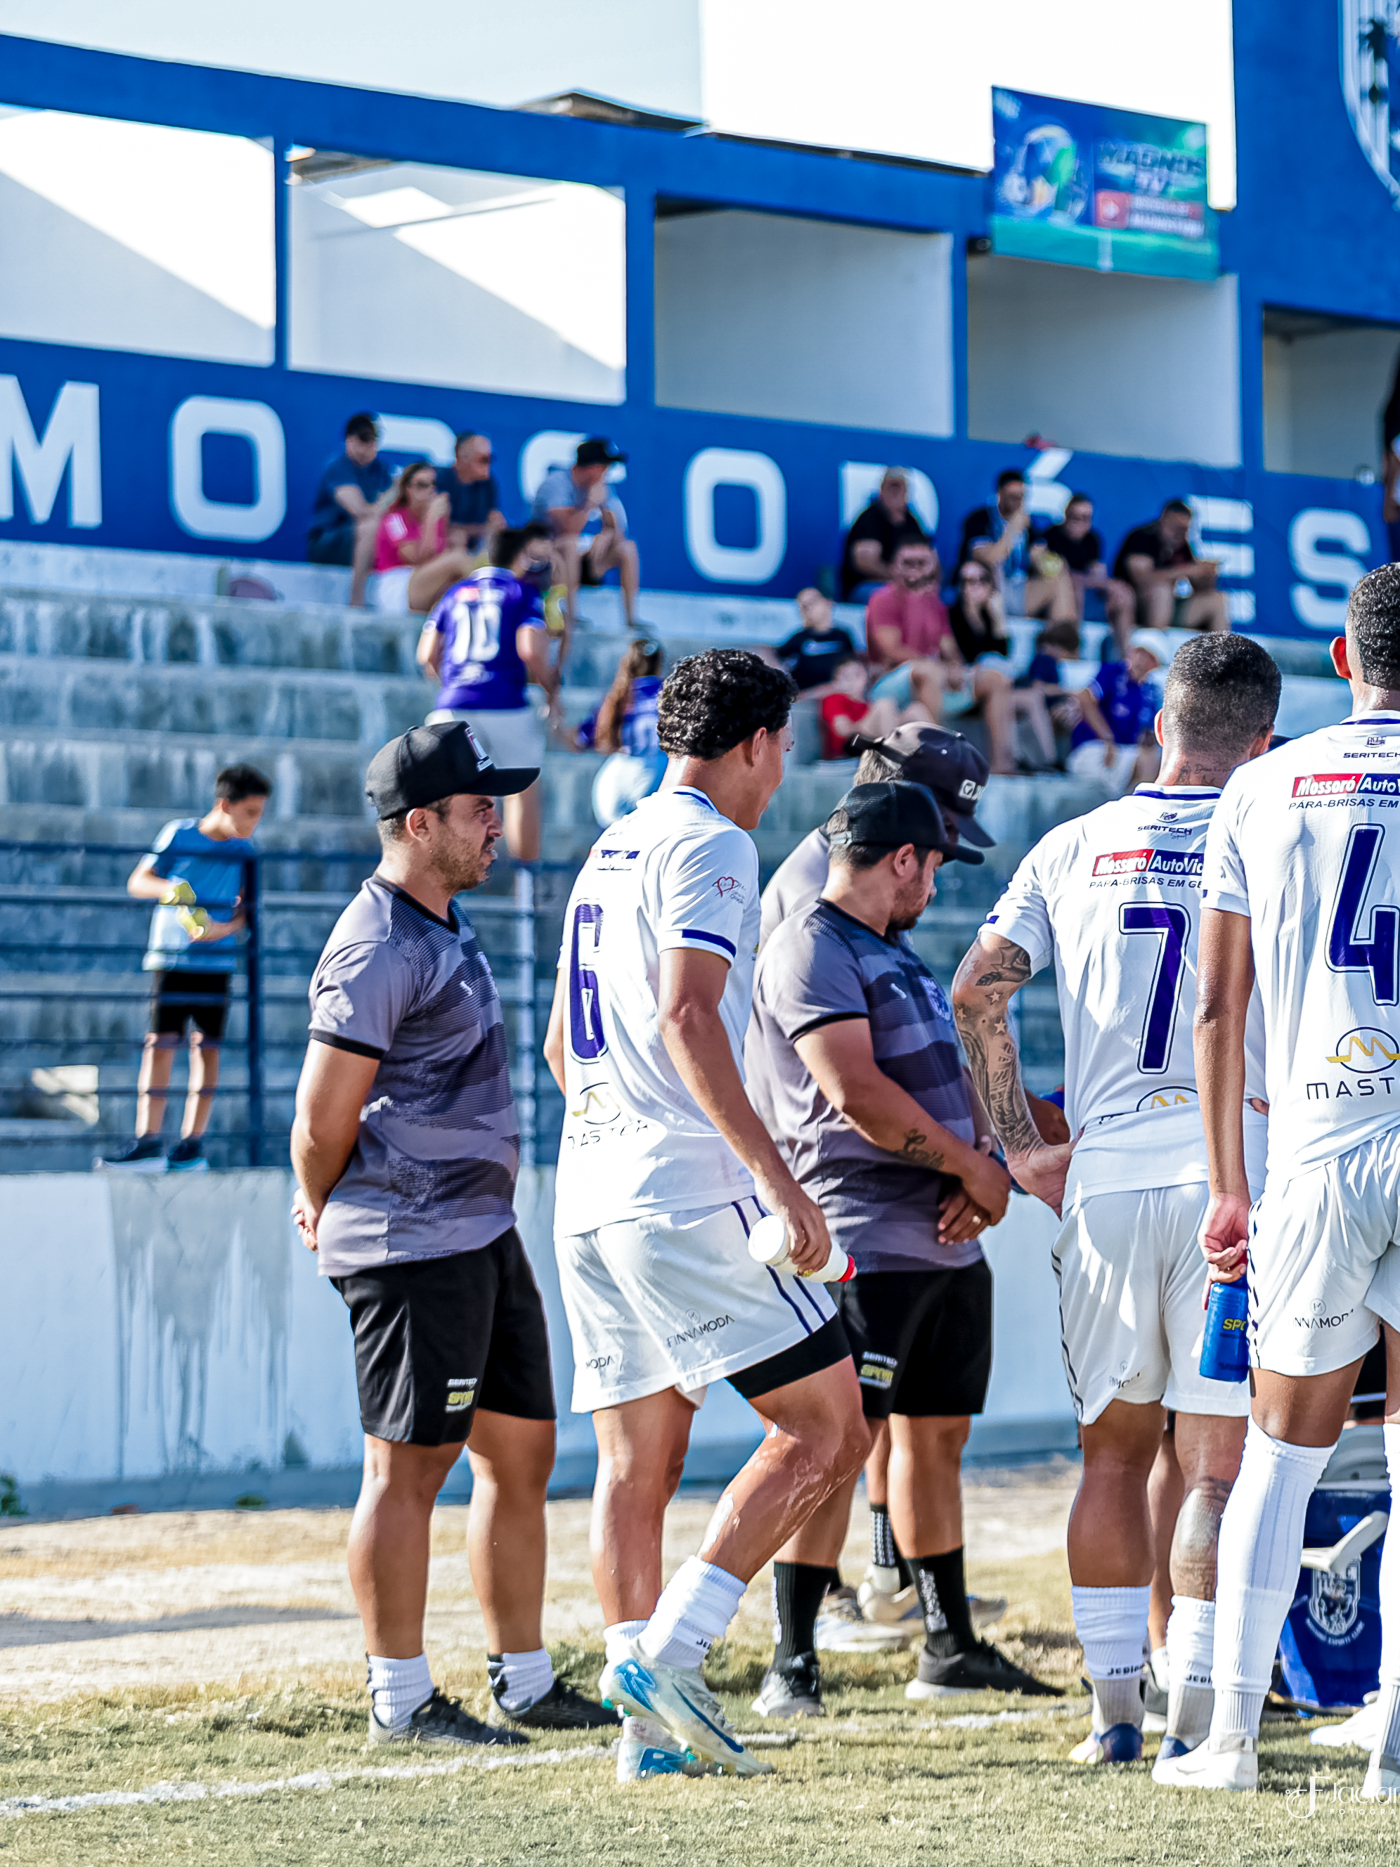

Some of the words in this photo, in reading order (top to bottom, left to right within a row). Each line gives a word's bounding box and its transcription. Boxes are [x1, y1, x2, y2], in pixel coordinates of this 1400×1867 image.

[453, 601, 501, 664] 10
[1295, 776, 1357, 797] Mossoró
[1378, 800, 1399, 809] EM
[1137, 824, 1193, 835] SERITECH
[1095, 852, 1147, 875] Mossoró
[1167, 879, 1185, 888] EM
[1324, 823, 1400, 1007] 4
[568, 897, 609, 1064] 6
[1119, 901, 1191, 1075] 7
